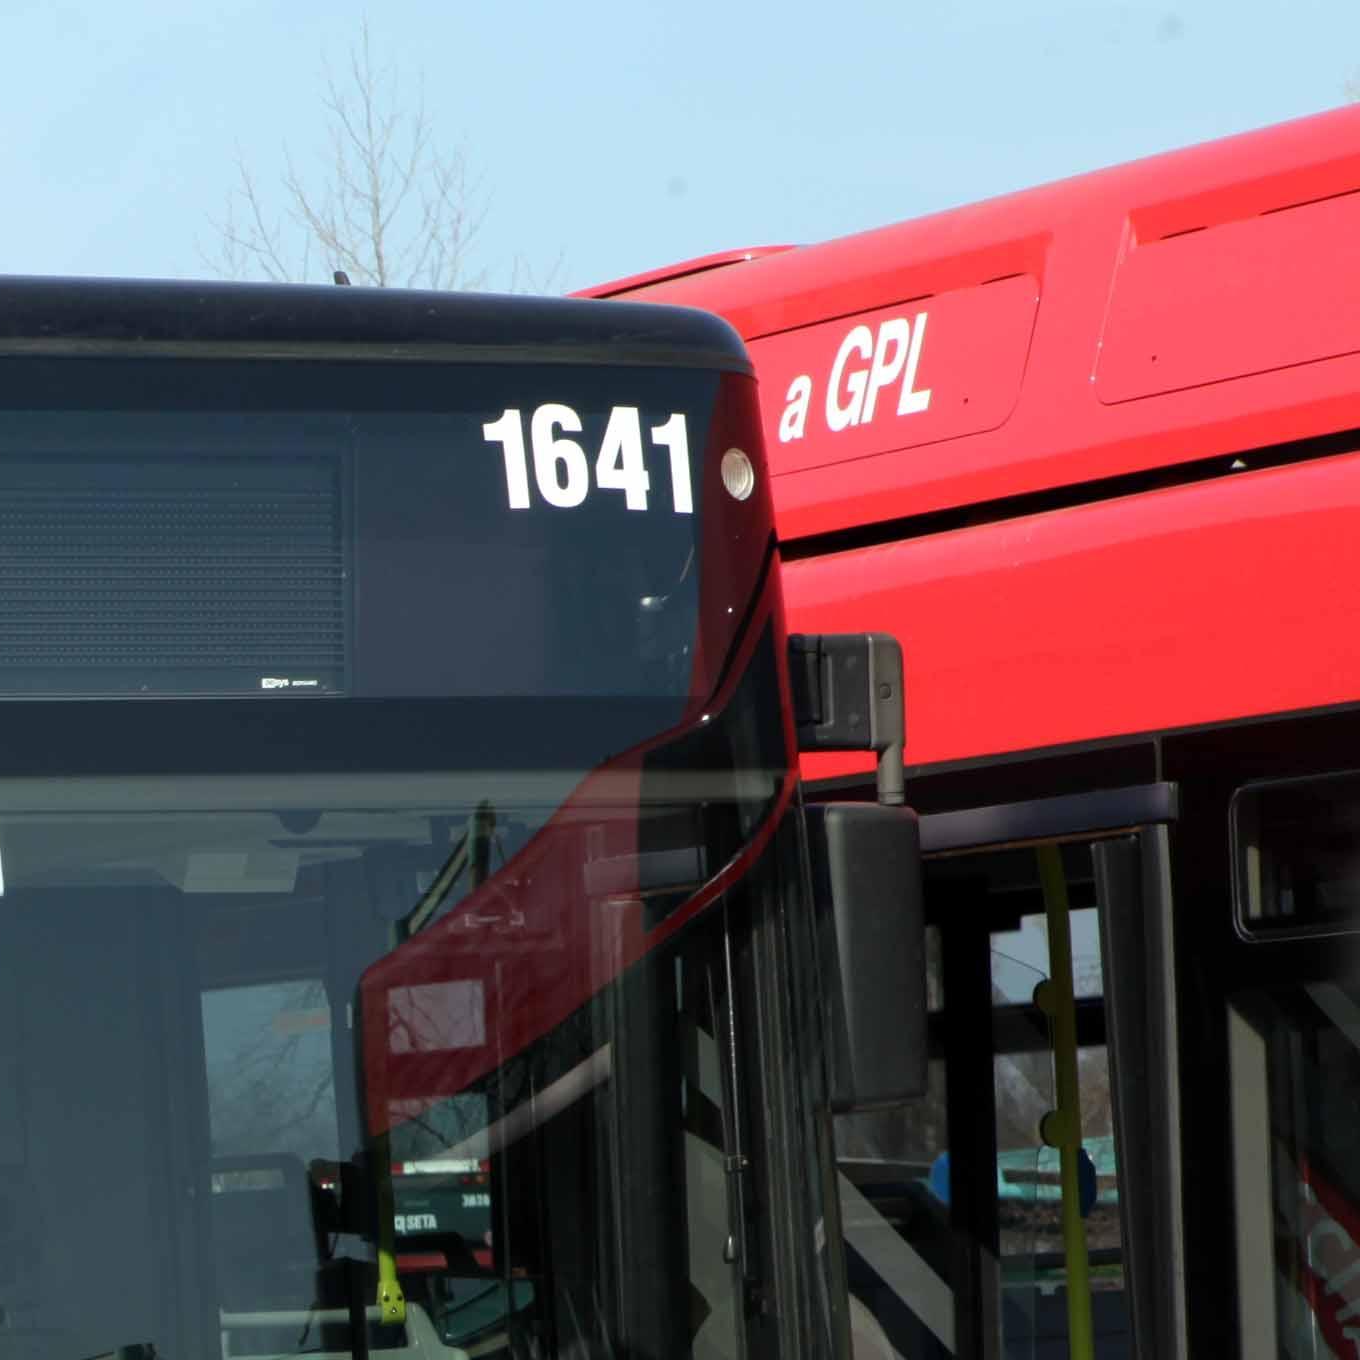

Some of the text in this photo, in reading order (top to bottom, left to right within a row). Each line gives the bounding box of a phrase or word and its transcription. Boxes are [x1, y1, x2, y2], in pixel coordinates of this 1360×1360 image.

[779, 312, 933, 443] a GPL
[482, 403, 695, 514] 1641
[406, 1214, 437, 1230] SETA
